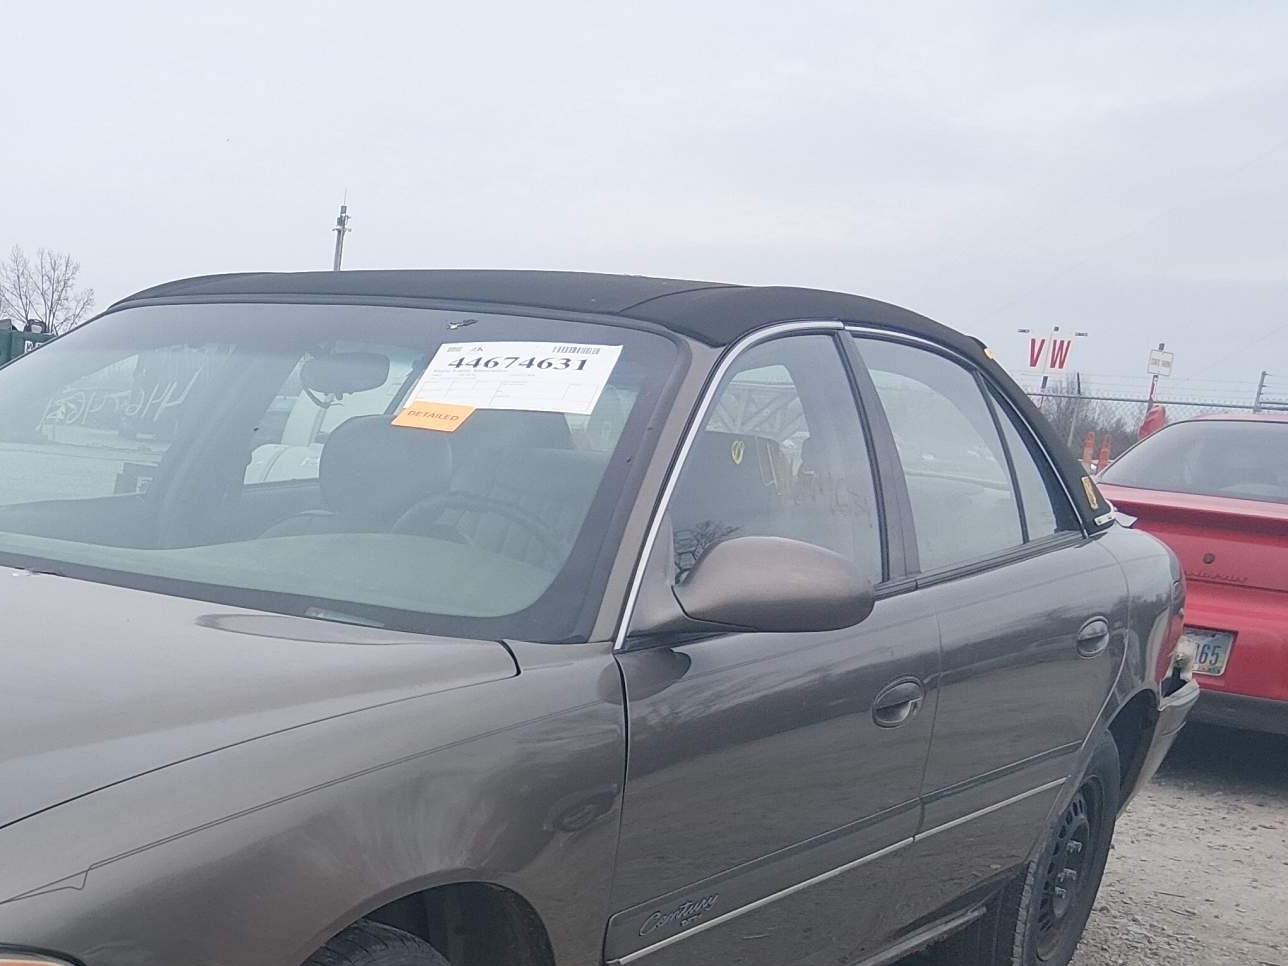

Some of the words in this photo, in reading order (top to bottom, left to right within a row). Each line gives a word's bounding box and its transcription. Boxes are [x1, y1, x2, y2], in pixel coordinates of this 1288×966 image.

[448, 356, 588, 371] 44674631
[407, 409, 460, 421] DETAILED
[638, 894, 719, 936] Century
